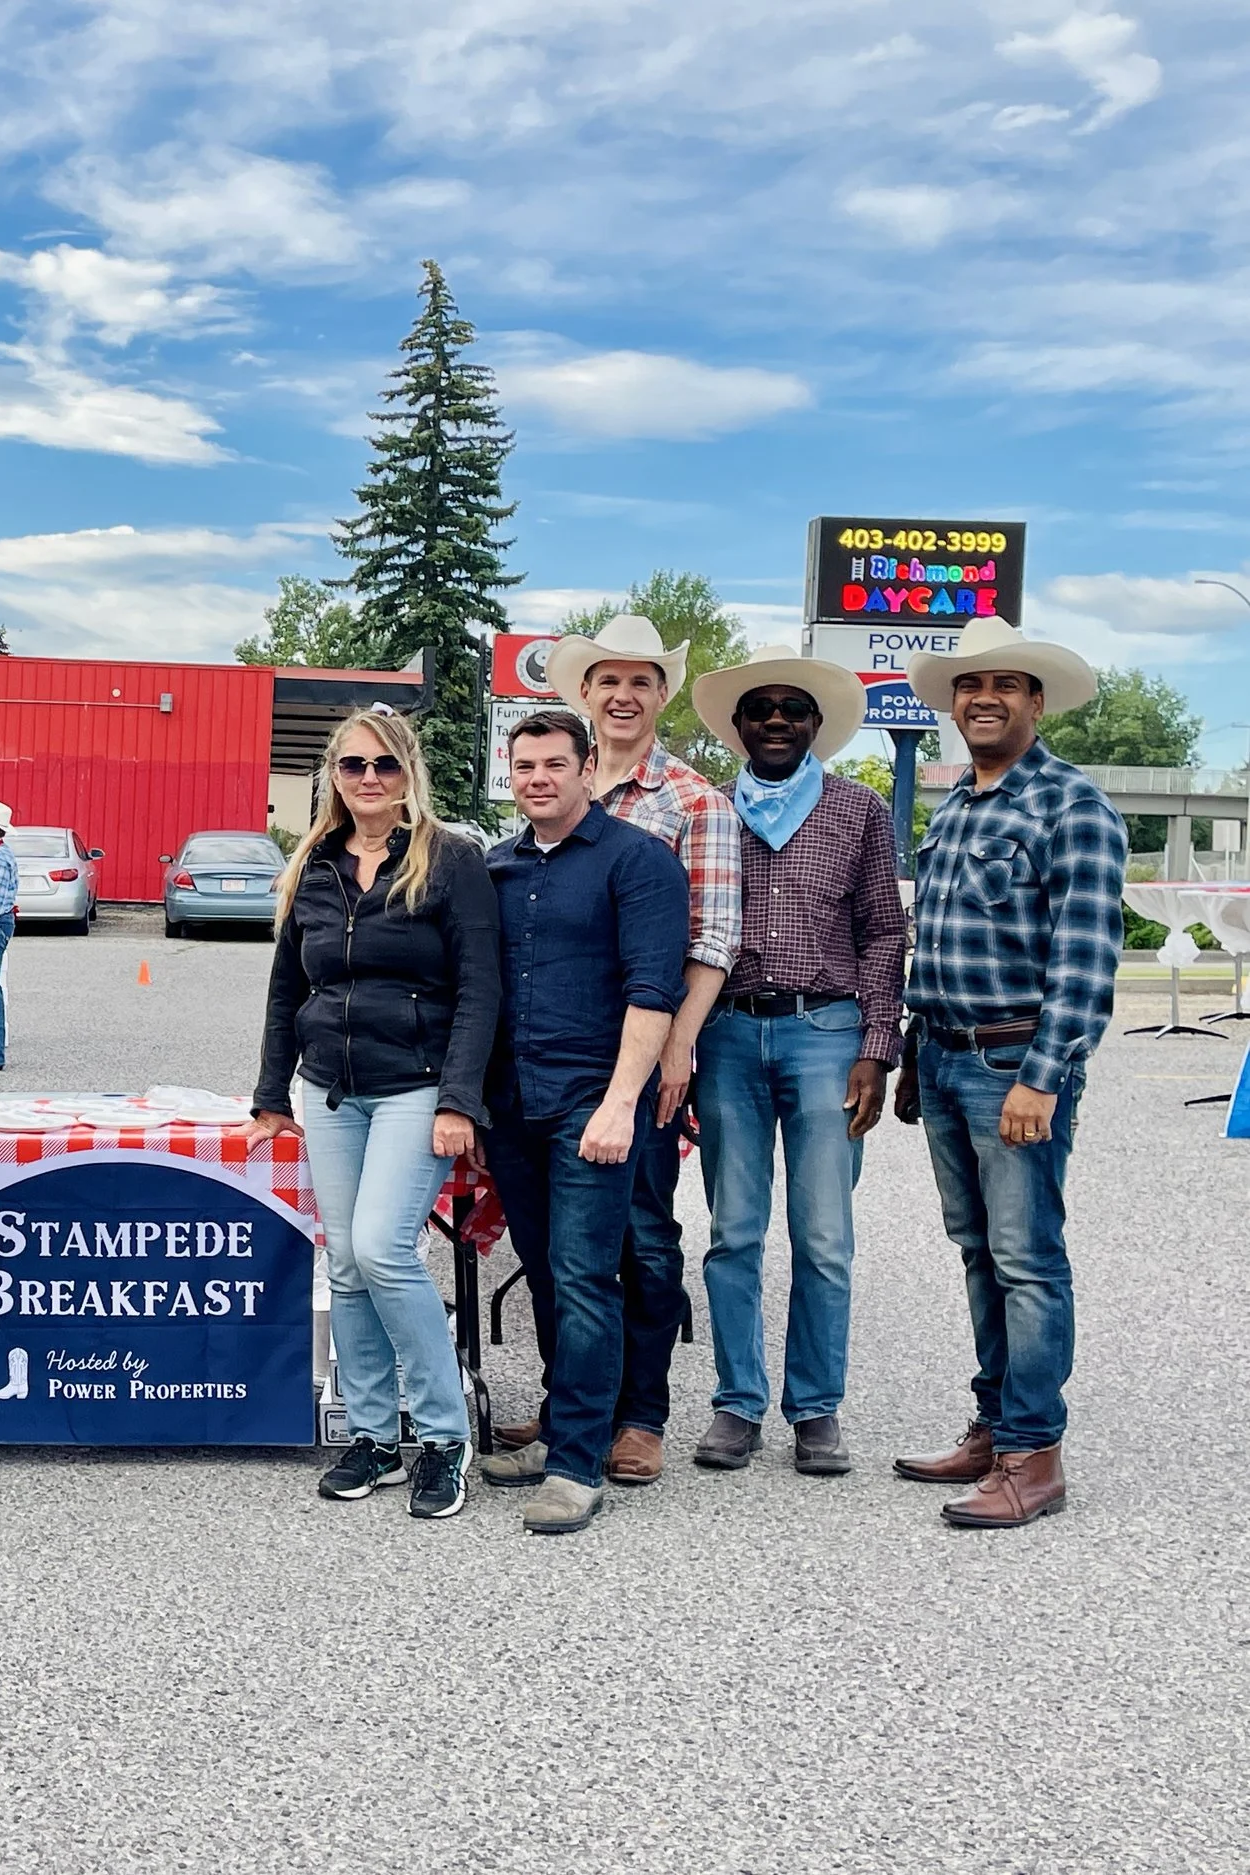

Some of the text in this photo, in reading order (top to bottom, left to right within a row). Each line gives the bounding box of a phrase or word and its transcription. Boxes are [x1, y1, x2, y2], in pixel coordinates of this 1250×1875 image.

[838, 528, 1007, 553] 403-402-3999
[870, 554, 997, 583] Richmond
[841, 583, 999, 617] DAYCARE
[872, 654, 905, 671] PL
[881, 694, 928, 708] POW
[865, 707, 939, 721] ROPERT
[495, 725, 508, 737] Ta
[491, 777, 511, 789] (40
[46, 1349, 150, 1379] Hosted by
[48, 1378, 248, 1400] POWER PROPERTIES
